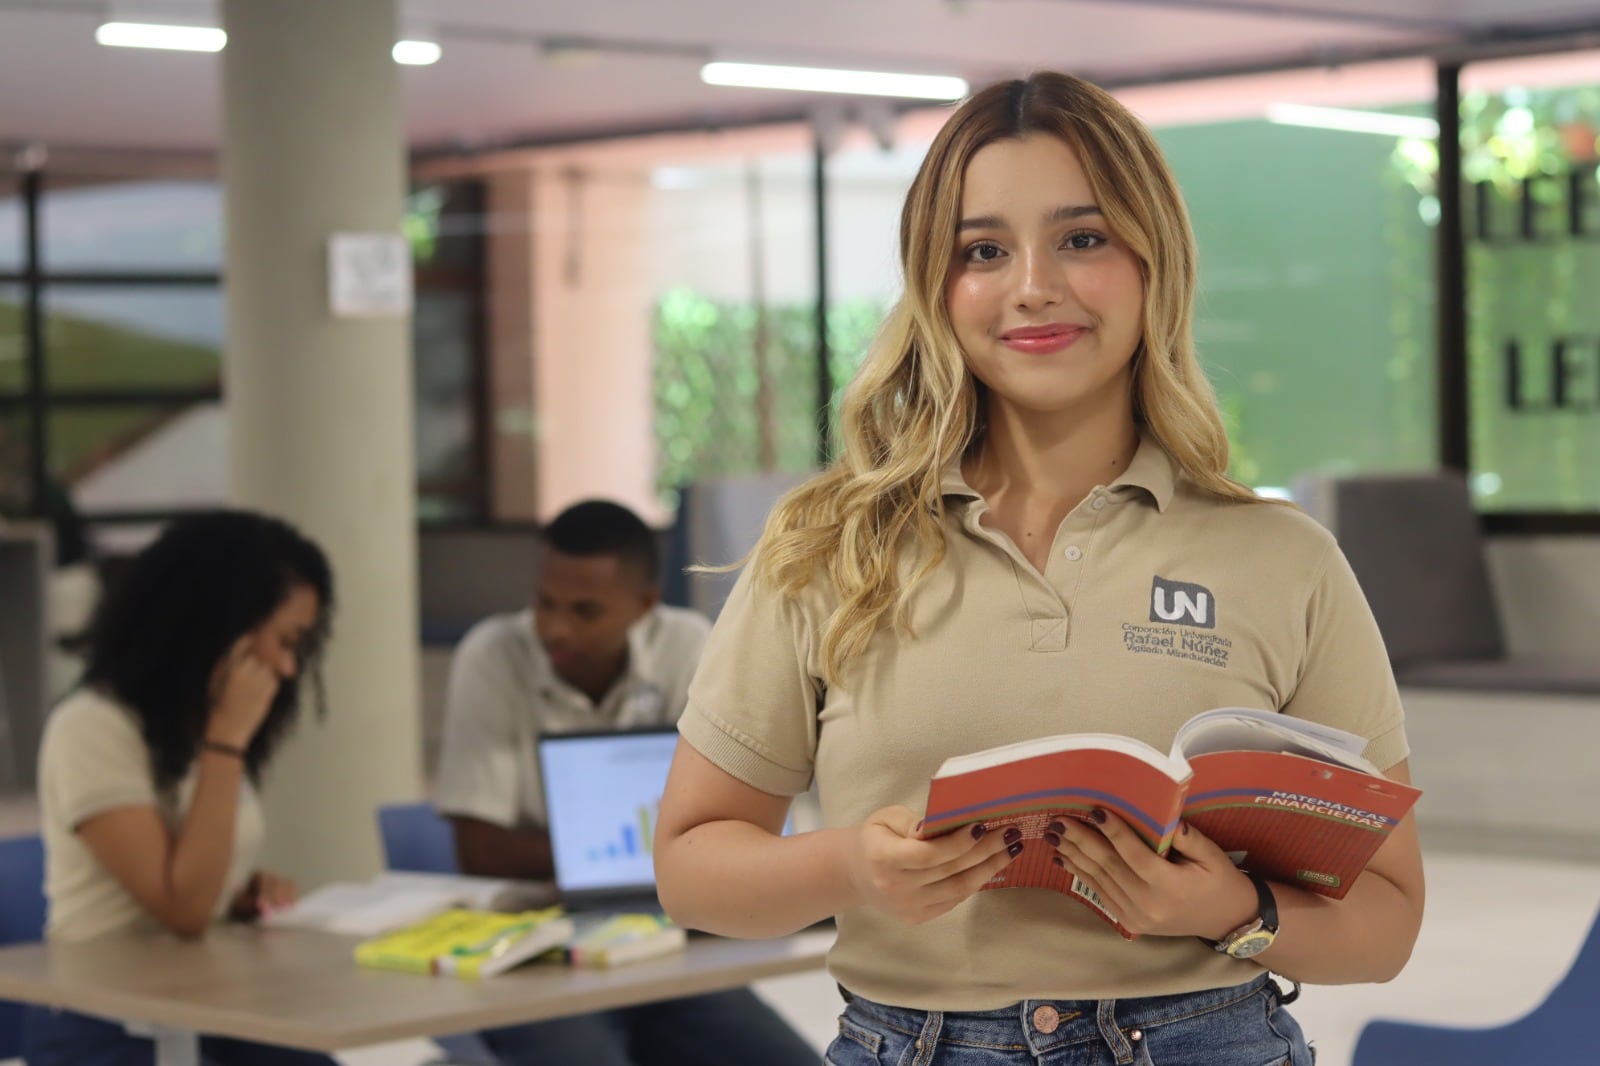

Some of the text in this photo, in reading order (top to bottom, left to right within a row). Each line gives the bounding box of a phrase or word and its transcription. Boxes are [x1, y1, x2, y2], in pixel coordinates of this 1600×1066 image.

[1507, 336, 1600, 411] LE
[1154, 587, 1207, 623] UN
[1122, 622, 1232, 648] Corporación Universitaria
[1124, 631, 1228, 660] Rafael Núñez
[1126, 643, 1227, 668] Vigilada Mineducación
[1254, 796, 1384, 828] FINANCIERAS
